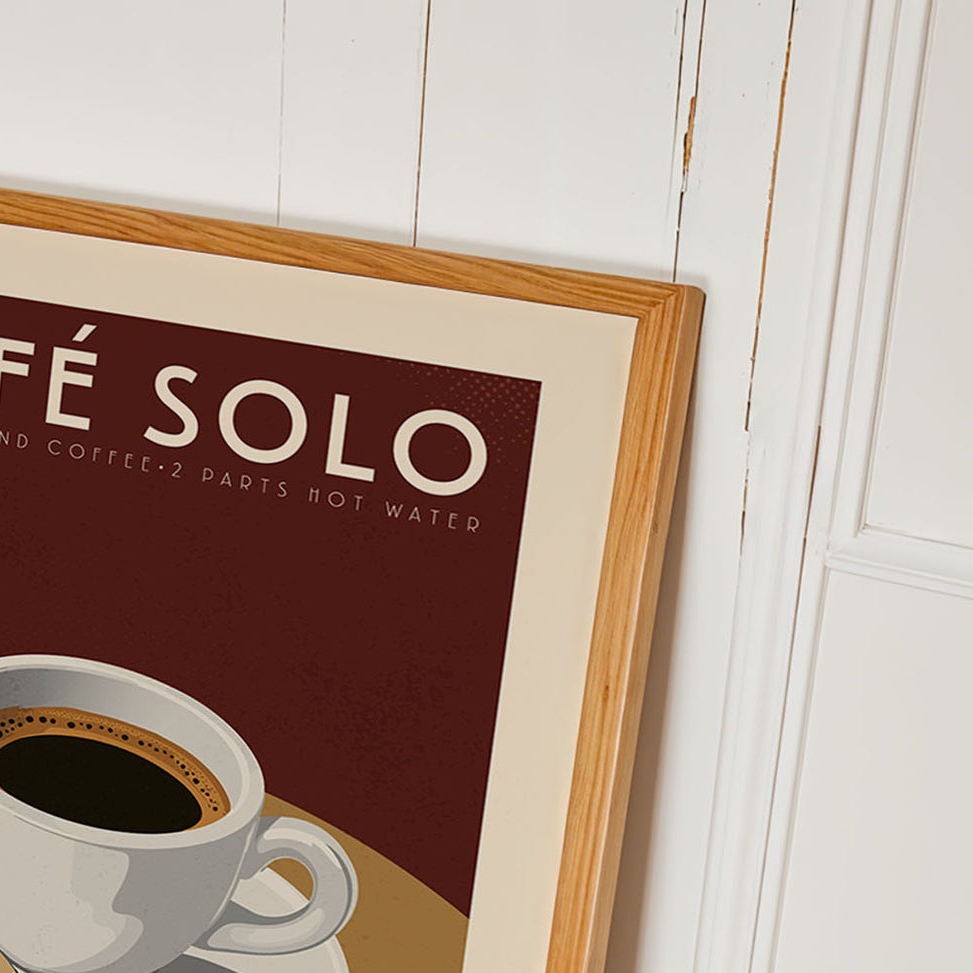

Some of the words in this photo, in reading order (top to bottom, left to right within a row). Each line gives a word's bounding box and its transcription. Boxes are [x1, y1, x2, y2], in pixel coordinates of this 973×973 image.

[143, 364, 488, 497] SOLO
[201, 467, 287, 497] PARTS
[308, 486, 364, 511] HOT
[385, 500, 480, 533] WATER
